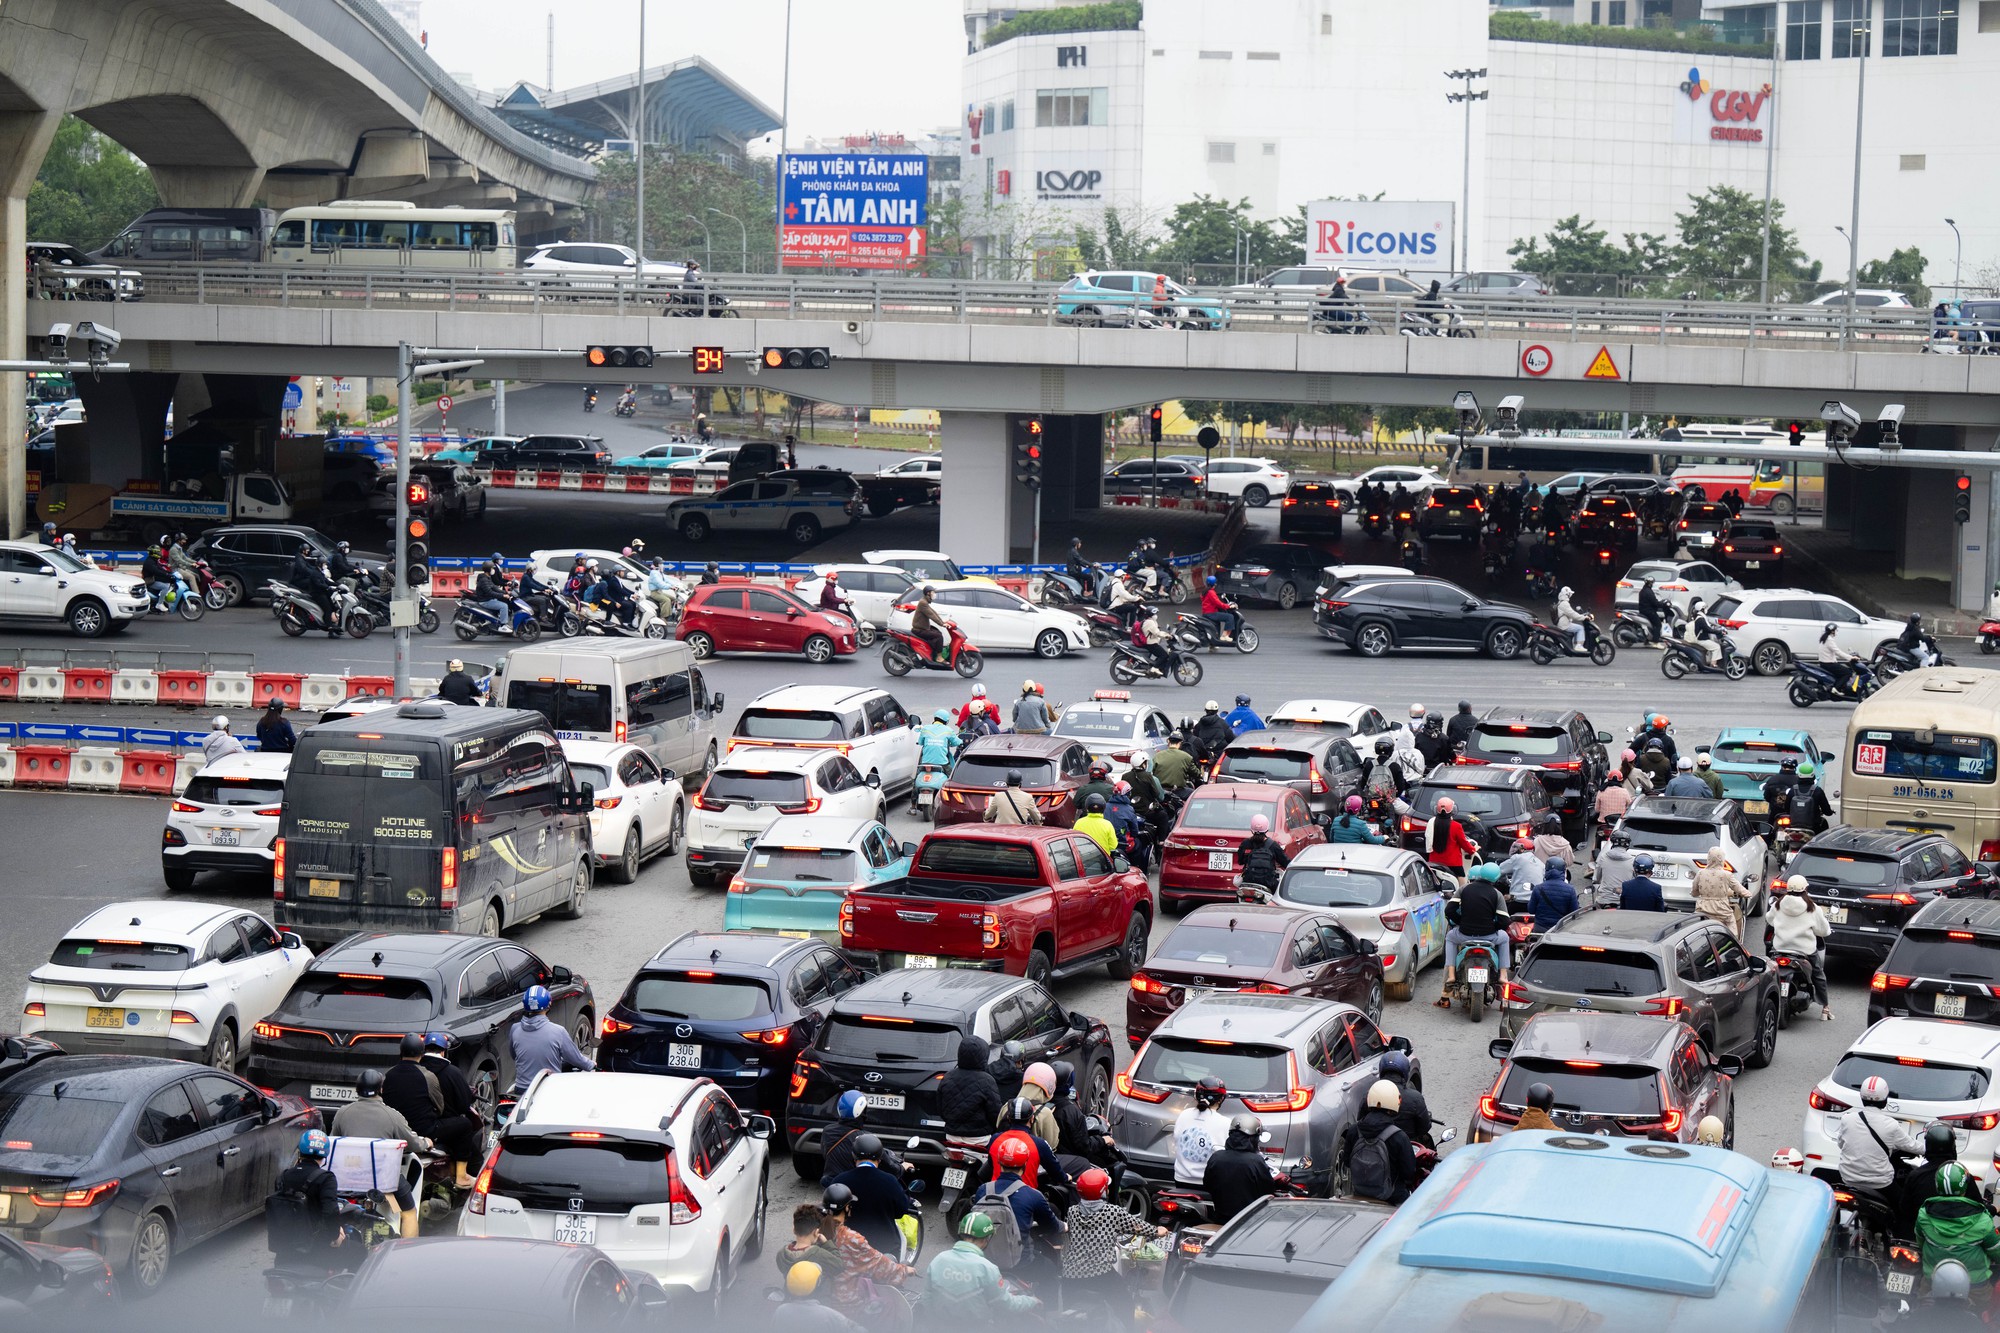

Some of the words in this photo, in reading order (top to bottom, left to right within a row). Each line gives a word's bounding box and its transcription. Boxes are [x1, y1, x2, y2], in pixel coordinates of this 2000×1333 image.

[1710, 89, 1766, 122] CGV
[1711, 126, 1763, 142] CINEMAS
[821, 157, 855, 179] VIỆN
[858, 158, 889, 176] TÂM
[892, 161, 924, 176] ANH
[801, 179, 832, 191] PHÒNG
[833, 179, 859, 191] KHÁM
[861, 182, 874, 192] ĐA
[875, 182, 900, 192] KHOA
[1036, 170, 1102, 191] LOOP
[801, 193, 855, 223] TÂM
[861, 199, 917, 224] ANH
[823, 234, 848, 246] 24/7
[858, 247, 871, 255] 265
[697, 349, 721, 371] 34
[411, 486, 425, 500] 34
[121, 501, 145, 510] CẢNH
[147, 501, 164, 511] SÁT
[166, 504, 187, 512] GIAO
[190, 504, 219, 514] THÔNG
[1969, 760, 1984, 772] 02
[1893, 785, 1954, 799] 29F-056.28
[326, 821, 350, 829] DONG
[381, 817, 425, 827] HOTLINE
[374, 827, 406, 838] 1900.63
[407, 828, 419, 838] 65
[420, 829, 433, 839] 86
[298, 863, 329, 871] HYUNDAI
[1942, 996, 1959, 1005] 30G
[98, 1008, 114, 1017] 29E
[1935, 1005, 1964, 1017] 400.83
[90, 1017, 120, 1026] 397.95
[677, 1045, 694, 1055] 30G
[669, 1055, 700, 1067] 238.40
[315, 1088, 359, 1099] 30E-707.
[1198, 1137, 1206, 1148] 8
[1959, 1174, 1967, 1188] Grab
[565, 1216, 587, 1229] 30E
[982, 1224, 994, 1234] Grab
[555, 1230, 593, 1244] 078.21
[942, 1267, 972, 1282] Grab
[1887, 1282, 1910, 1294] 193.50
